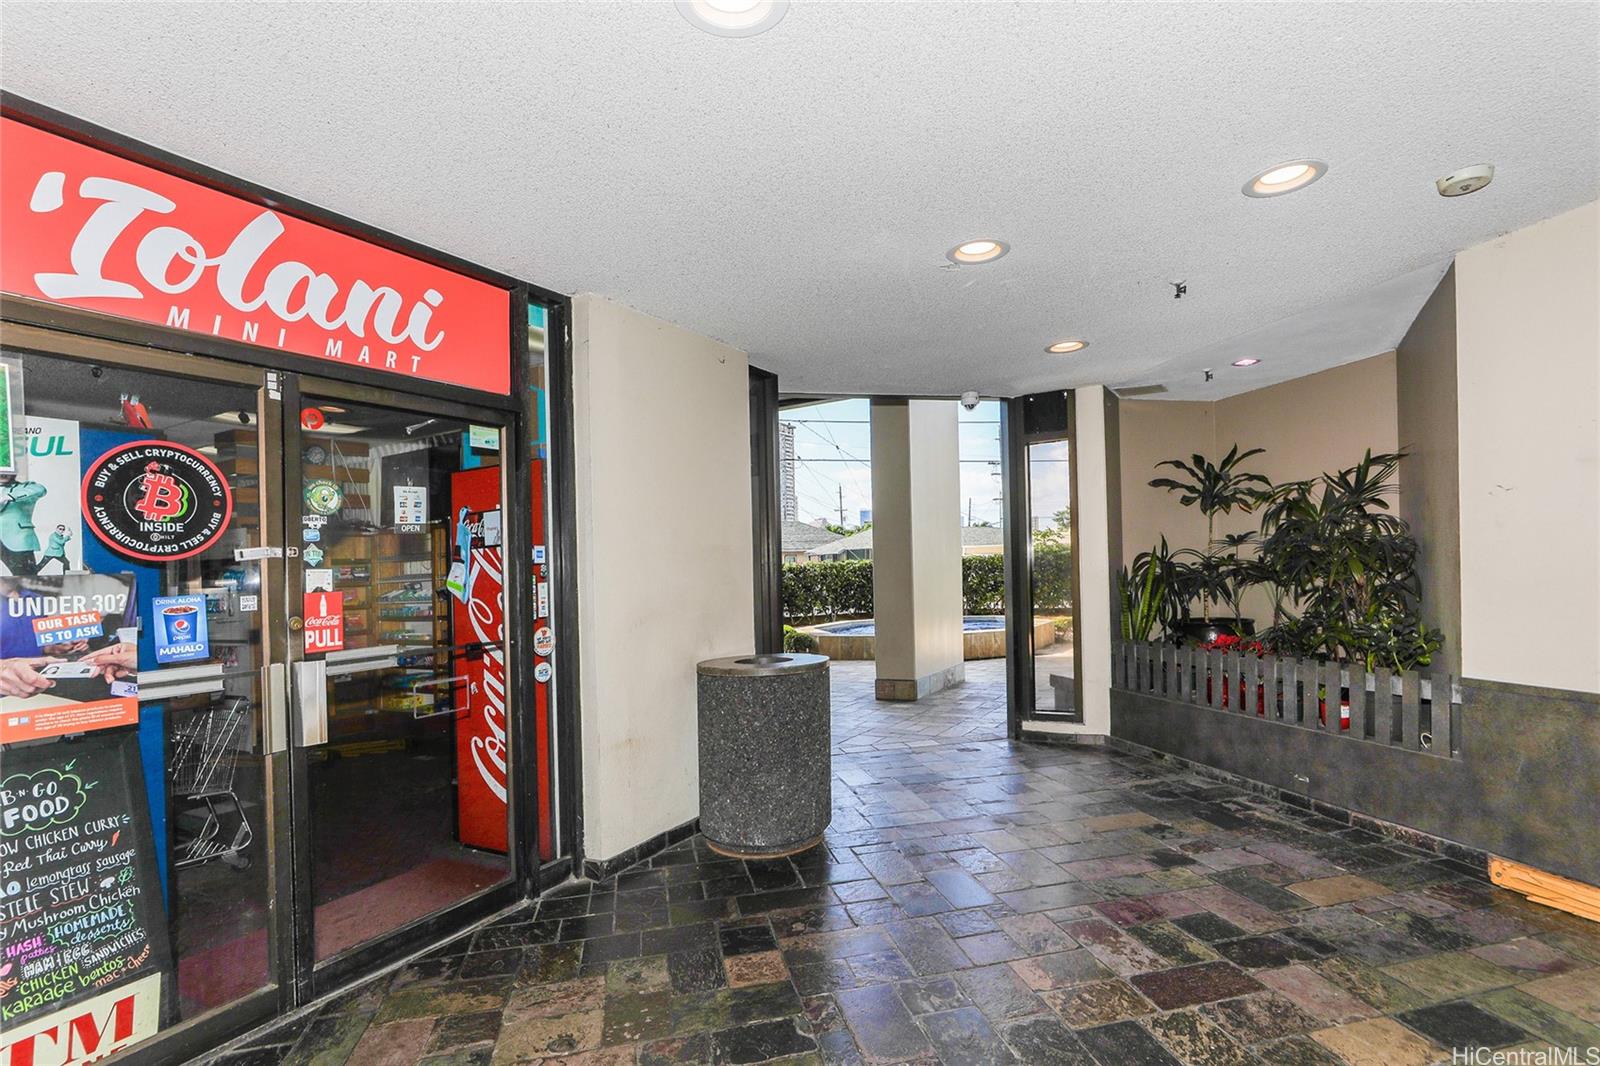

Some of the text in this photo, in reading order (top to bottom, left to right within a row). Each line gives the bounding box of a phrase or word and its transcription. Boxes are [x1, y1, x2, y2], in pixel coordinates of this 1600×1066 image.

[166, 306, 421, 373] MINI MART
[95, 448, 223, 497] BUY & SELL CRYPTOCURRENCY
[94, 506, 222, 553] BUY & SELL CRYPTOCURRENCY
[140, 522, 185, 533] INSIDE
[8, 593, 127, 617] UNDER 30?
[155, 598, 176, 606] DRINK
[37, 613, 97, 631] OUR TASK
[40, 625, 100, 643] IS TO ASK
[304, 628, 343, 649] PULL
[159, 643, 204, 656] MAHALO
[32, 781, 58, 798] GO
[3, 796, 70, 829] FOOD
[25, 826, 79, 850] CHICKEN
[84, 814, 121, 836] CURRY
[2, 838, 108, 879] Red Thai Curry
[26, 861, 91, 889] lemongrass
[97, 848, 137, 867] sausage
[50, 879, 90, 904] STEW
[11, 903, 87, 938] Mushroom
[89, 886, 141, 910] Chicken
[54, 904, 127, 938] HOMEMADE
[6, 936, 43, 958] HASH
[71, 917, 130, 945] desserts
[84, 927, 144, 967] SANDWICHES
[23, 955, 55, 978] HAM
[63, 943, 90, 964] EGG
[79, 955, 126, 988] bentos
[20, 962, 79, 995] CHICKEN
[95, 970, 121, 988] mac
